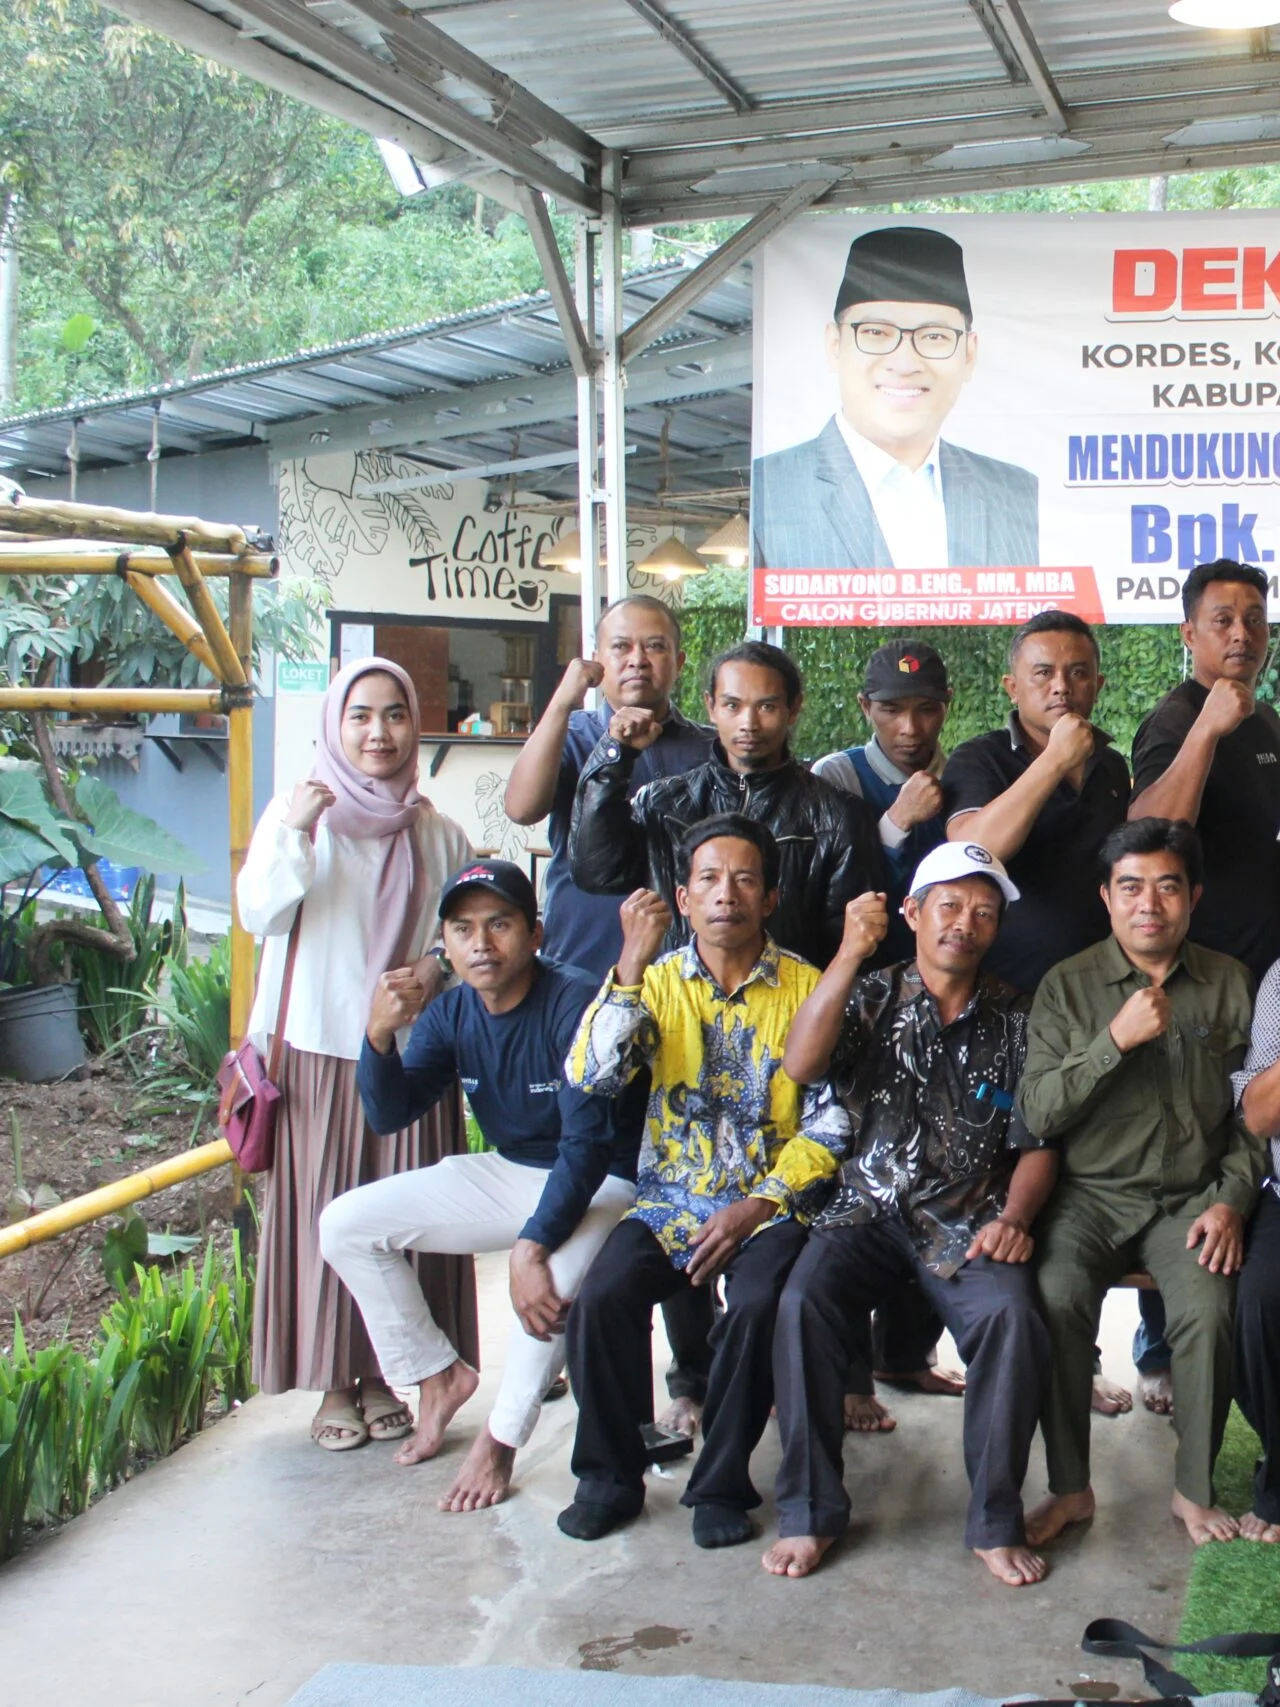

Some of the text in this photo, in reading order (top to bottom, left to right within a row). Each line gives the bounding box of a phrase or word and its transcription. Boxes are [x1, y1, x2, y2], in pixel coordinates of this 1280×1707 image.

[1081, 341, 1242, 371] KORDES,
[1130, 502, 1275, 570] Bpk.
[408, 552, 517, 601] Time
[765, 574, 897, 596] SUDARYONO
[1026, 571, 1076, 593] MBA
[1116, 576, 1183, 601] PAD
[781, 603, 855, 621] CALON
[859, 603, 972, 621] GUBERNUR
[281, 667, 324, 681] LOKET
